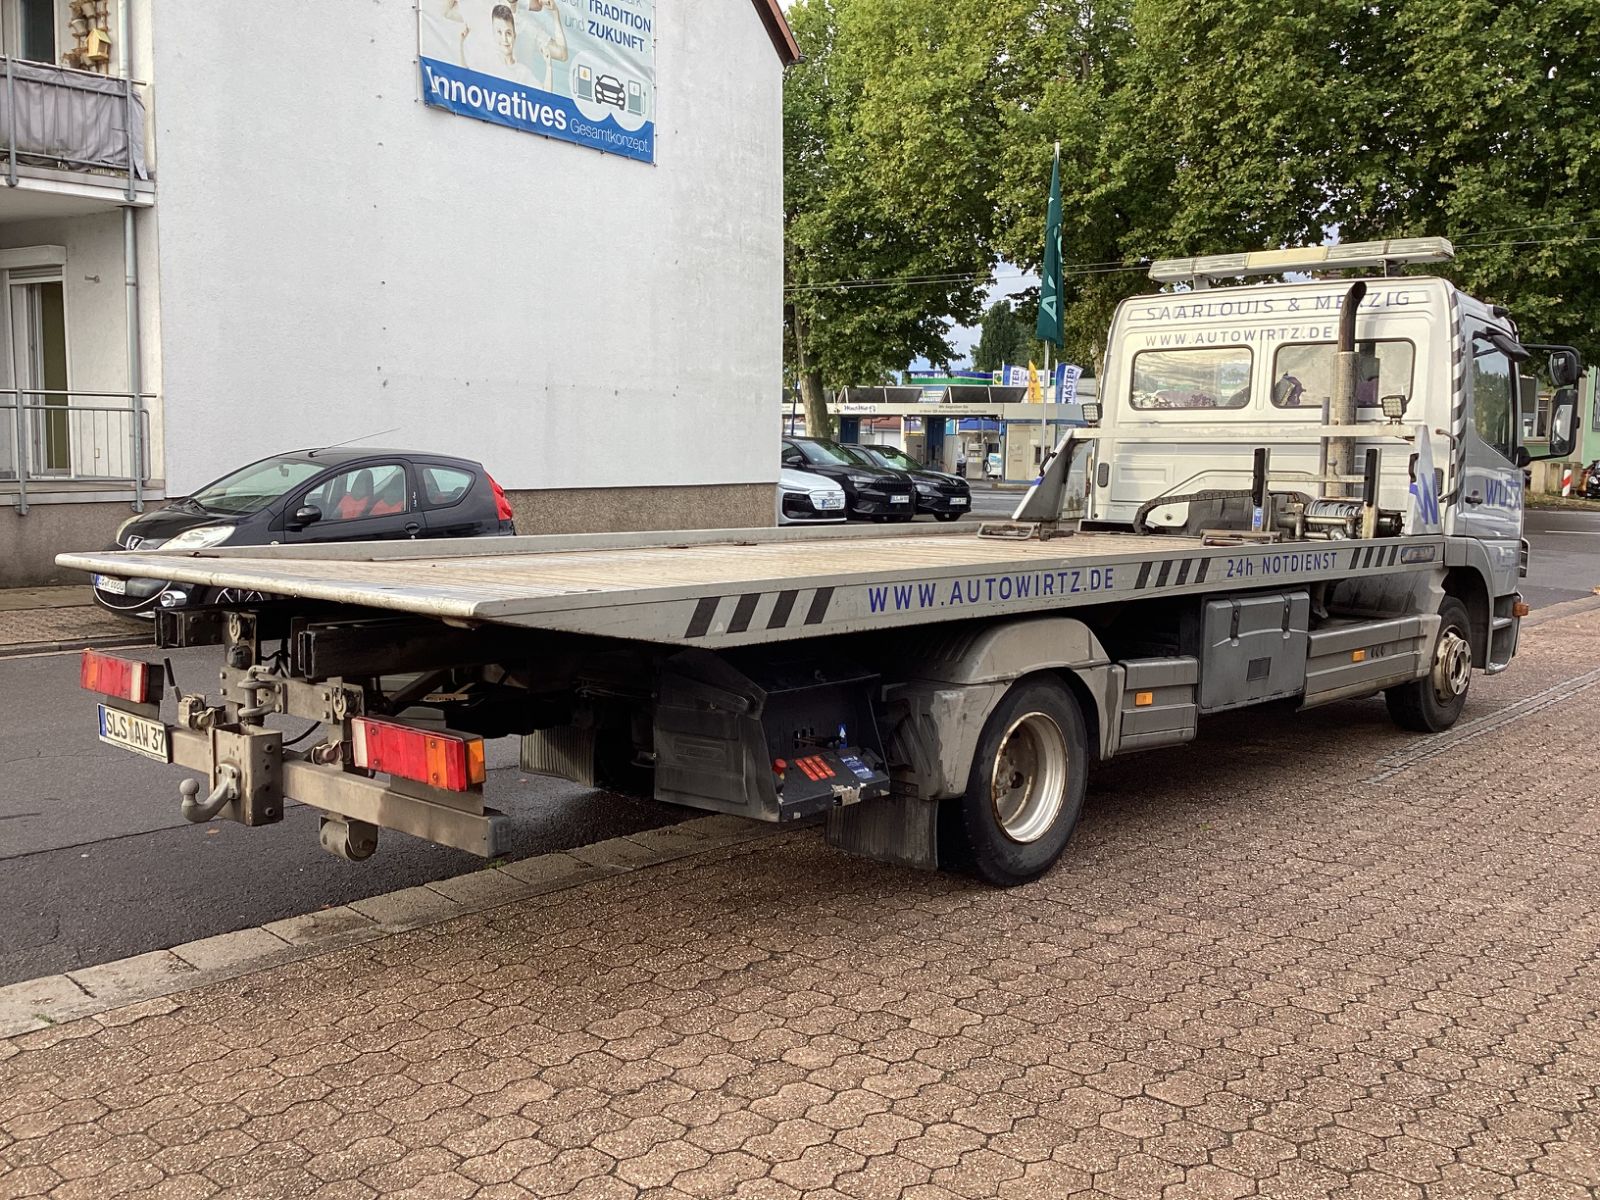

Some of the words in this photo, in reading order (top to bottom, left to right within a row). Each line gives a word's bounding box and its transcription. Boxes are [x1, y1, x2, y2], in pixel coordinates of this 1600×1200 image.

[588, 0, 651, 32] TRADITION
[425, 65, 567, 131] Innovatives
[1146, 298, 1274, 321] SAARLOUIS
[1288, 297, 1300, 311] &
[1315, 290, 1411, 310] MEZIG
[1145, 325, 1333, 347] WWW.AUTOWIRTZ.DE
[1064, 368, 1076, 404] MASTER
[1226, 557, 1253, 578] 24h
[1262, 551, 1338, 575] NOTDIENST
[868, 567, 1115, 613] WWW.AUTOWIRTZ.DE
[106, 711, 128, 740] SLS
[134, 721, 149, 748] AW
[151, 727, 164, 754] 37
